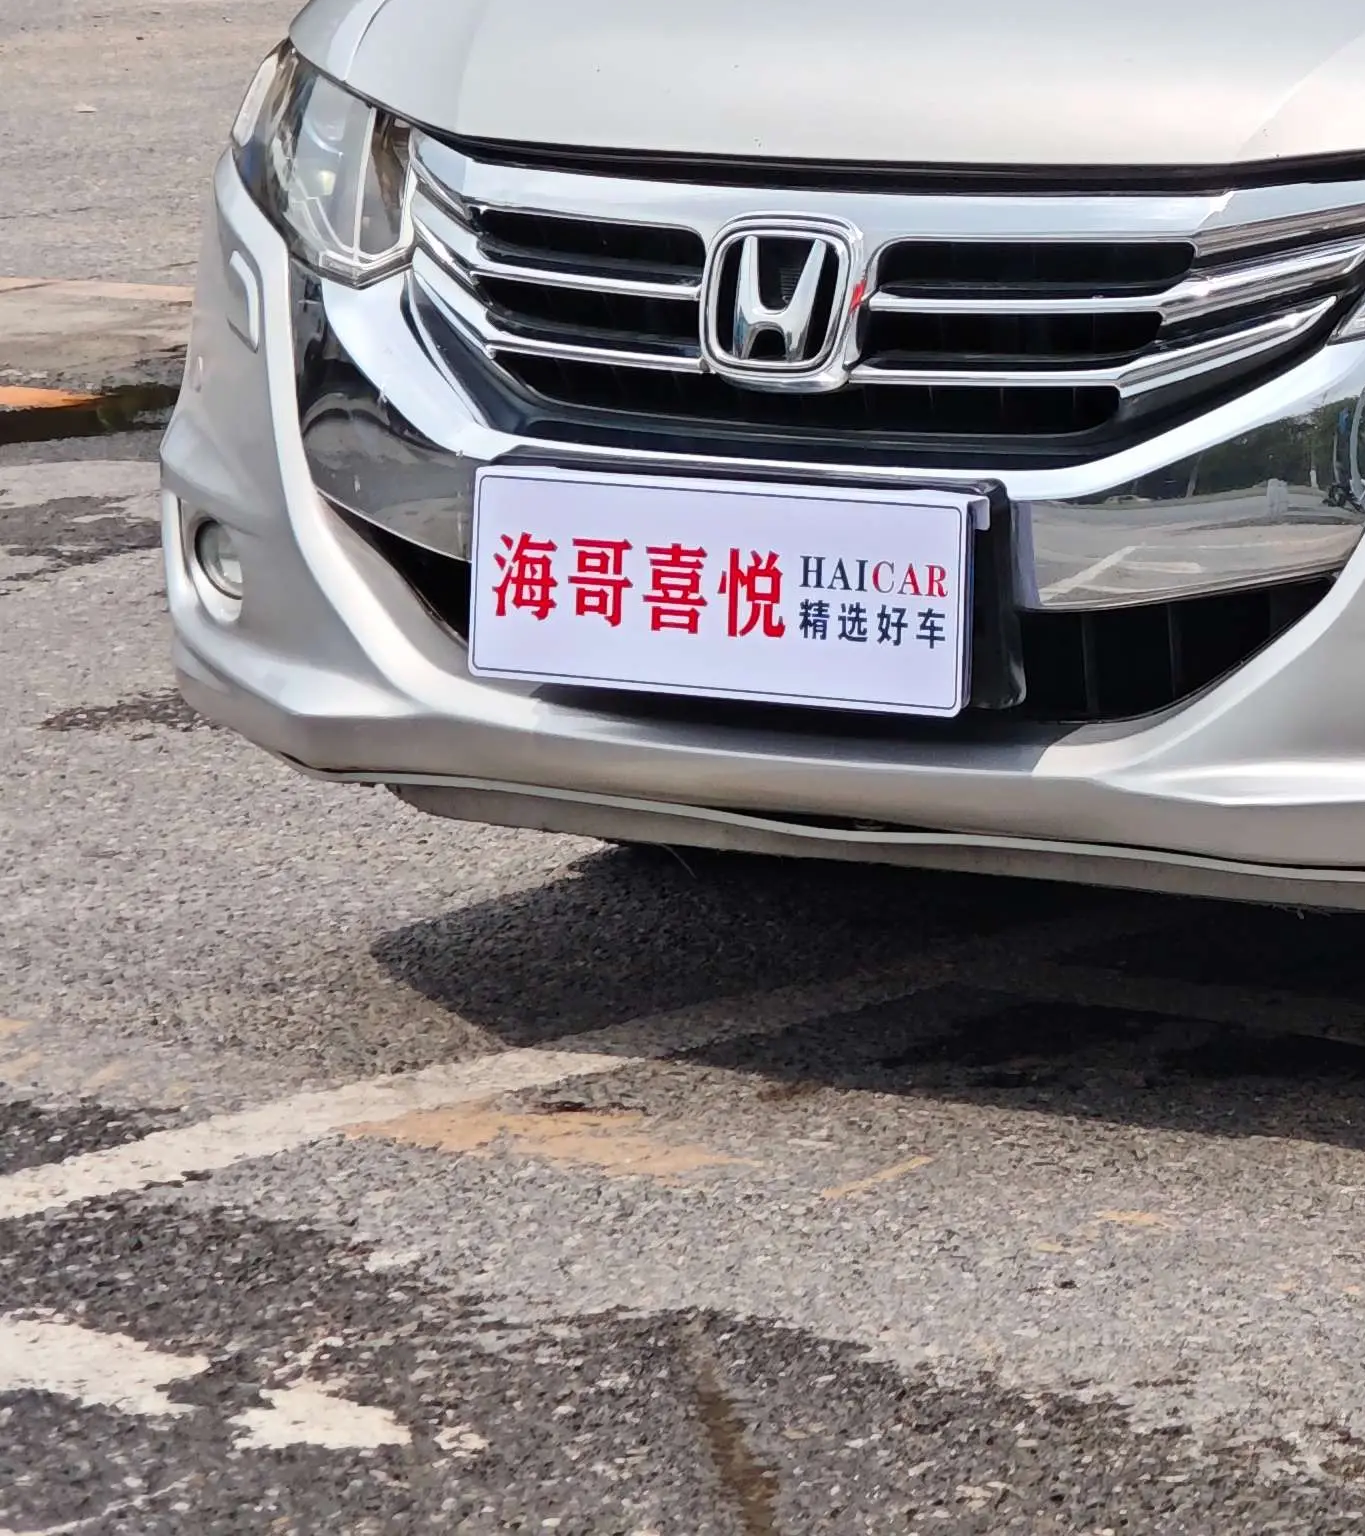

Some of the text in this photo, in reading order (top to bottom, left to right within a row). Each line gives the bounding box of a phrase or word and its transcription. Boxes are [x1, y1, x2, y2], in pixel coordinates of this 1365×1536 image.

[493, 531, 949, 639] 海哥喜悦 HAICAR
[799, 599, 947, 650] 精选好车
